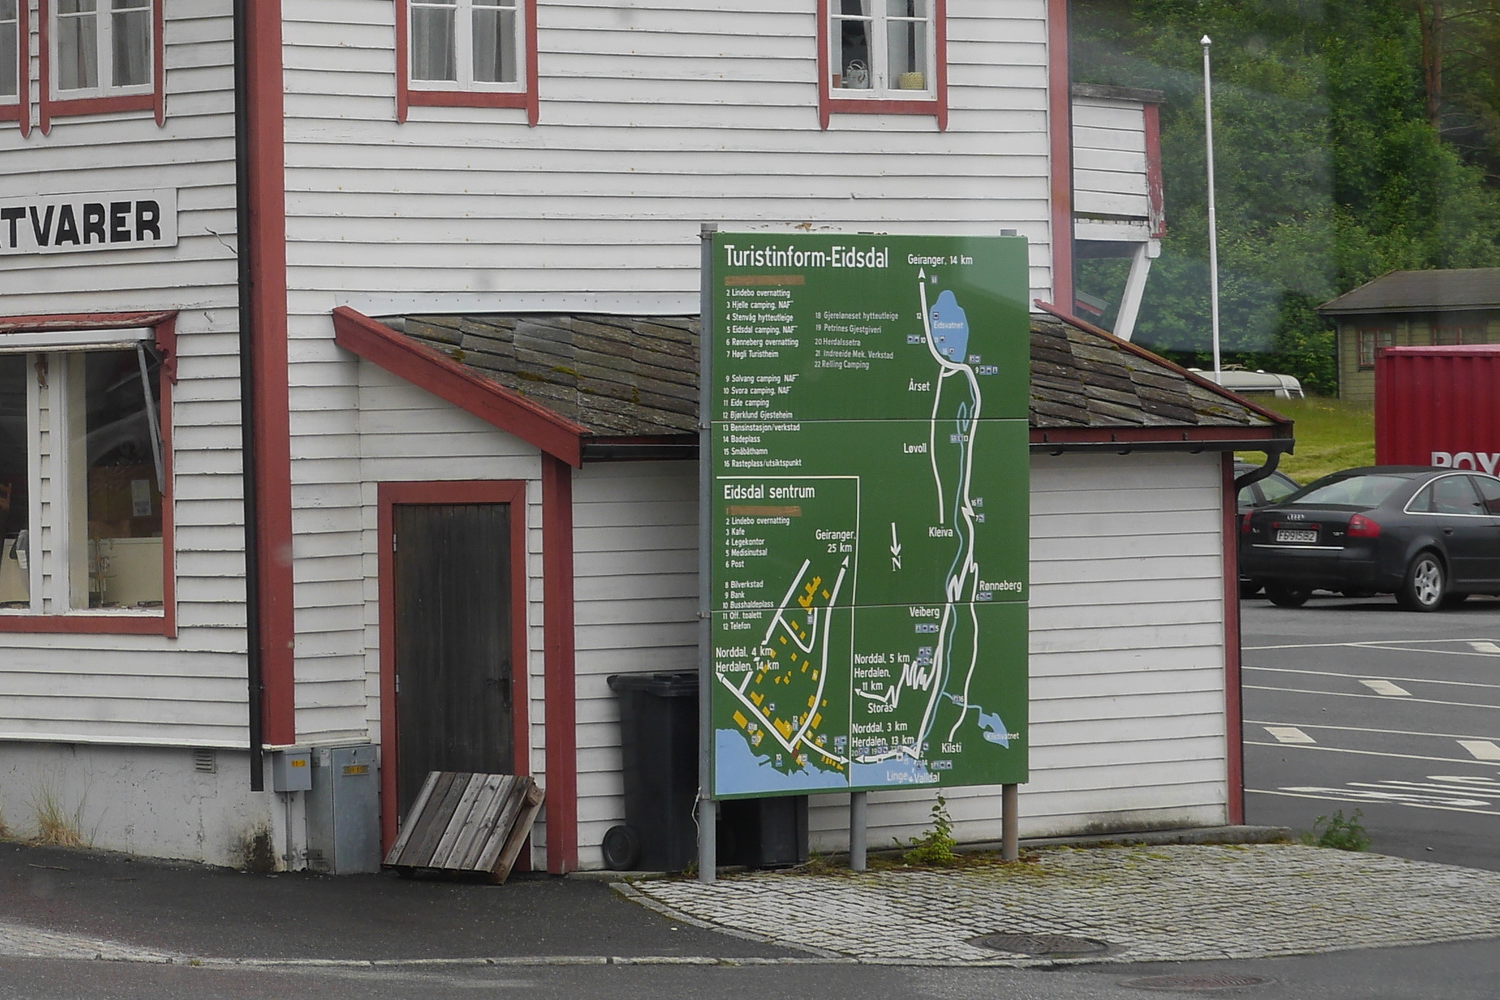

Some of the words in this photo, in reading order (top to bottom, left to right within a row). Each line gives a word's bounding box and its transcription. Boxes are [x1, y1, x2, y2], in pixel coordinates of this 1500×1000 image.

[724, 244, 888, 268] Turistinform-Eidsdal
[950, 256, 958, 264] 14
[961, 255, 973, 264] km
[732, 288, 754, 296] Lindebo
[756, 289, 790, 298] overnatting
[732, 300, 748, 310] Hjelle
[758, 313, 794, 323] hytteutleige
[862, 312, 898, 321] hytteutleige
[732, 325, 753, 334] Eidsdal
[824, 324, 848, 332] Petrines
[849, 324, 882, 334] Gjestgiveri
[765, 338, 799, 348] overnatting
[748, 350, 779, 358] Turistheim
[868, 351, 894, 359] Verkstad
[844, 360, 870, 370] Camping
[732, 374, 754, 384] Solvang
[908, 378, 930, 391] Årset
[731, 386, 748, 394] Svora
[730, 398, 743, 406] Eide
[745, 398, 769, 408] camping
[760, 410, 793, 420] Gjesteheim
[731, 435, 761, 443] Badeplass
[724, 484, 764, 499] Eidsdal
[770, 486, 815, 499] sentrum
[731, 517, 754, 525] Lindebo
[757, 517, 790, 526] overnatting
[731, 528, 745, 536] Kafe
[929, 526, 953, 537] Kleiva
[731, 538, 765, 547] Legekontor
[828, 544, 837, 553] 25
[840, 543, 852, 552] km
[731, 560, 744, 568] Post
[892, 556, 901, 571] N
[731, 580, 763, 589] Bilverkstad
[980, 581, 1022, 592] Rønneberg
[909, 607, 940, 619] Veiberg
[730, 622, 751, 630] Telefon
[752, 647, 757, 656] 4
[760, 646, 772, 656] km
[890, 654, 894, 663] 5
[898, 653, 910, 662] km
[756, 661, 764, 670] 14
[767, 660, 779, 670] km
[862, 682, 868, 690] 11
[870, 681, 883, 690] km
[868, 702, 893, 713] Storås
[887, 723, 892, 732] 3
[895, 721, 908, 731] km
[892, 736, 899, 746] 13
[902, 735, 914, 745] km
[942, 742, 962, 753] Kilsti
[887, 771, 909, 783] Linge
[914, 772, 940, 783] Valldal
